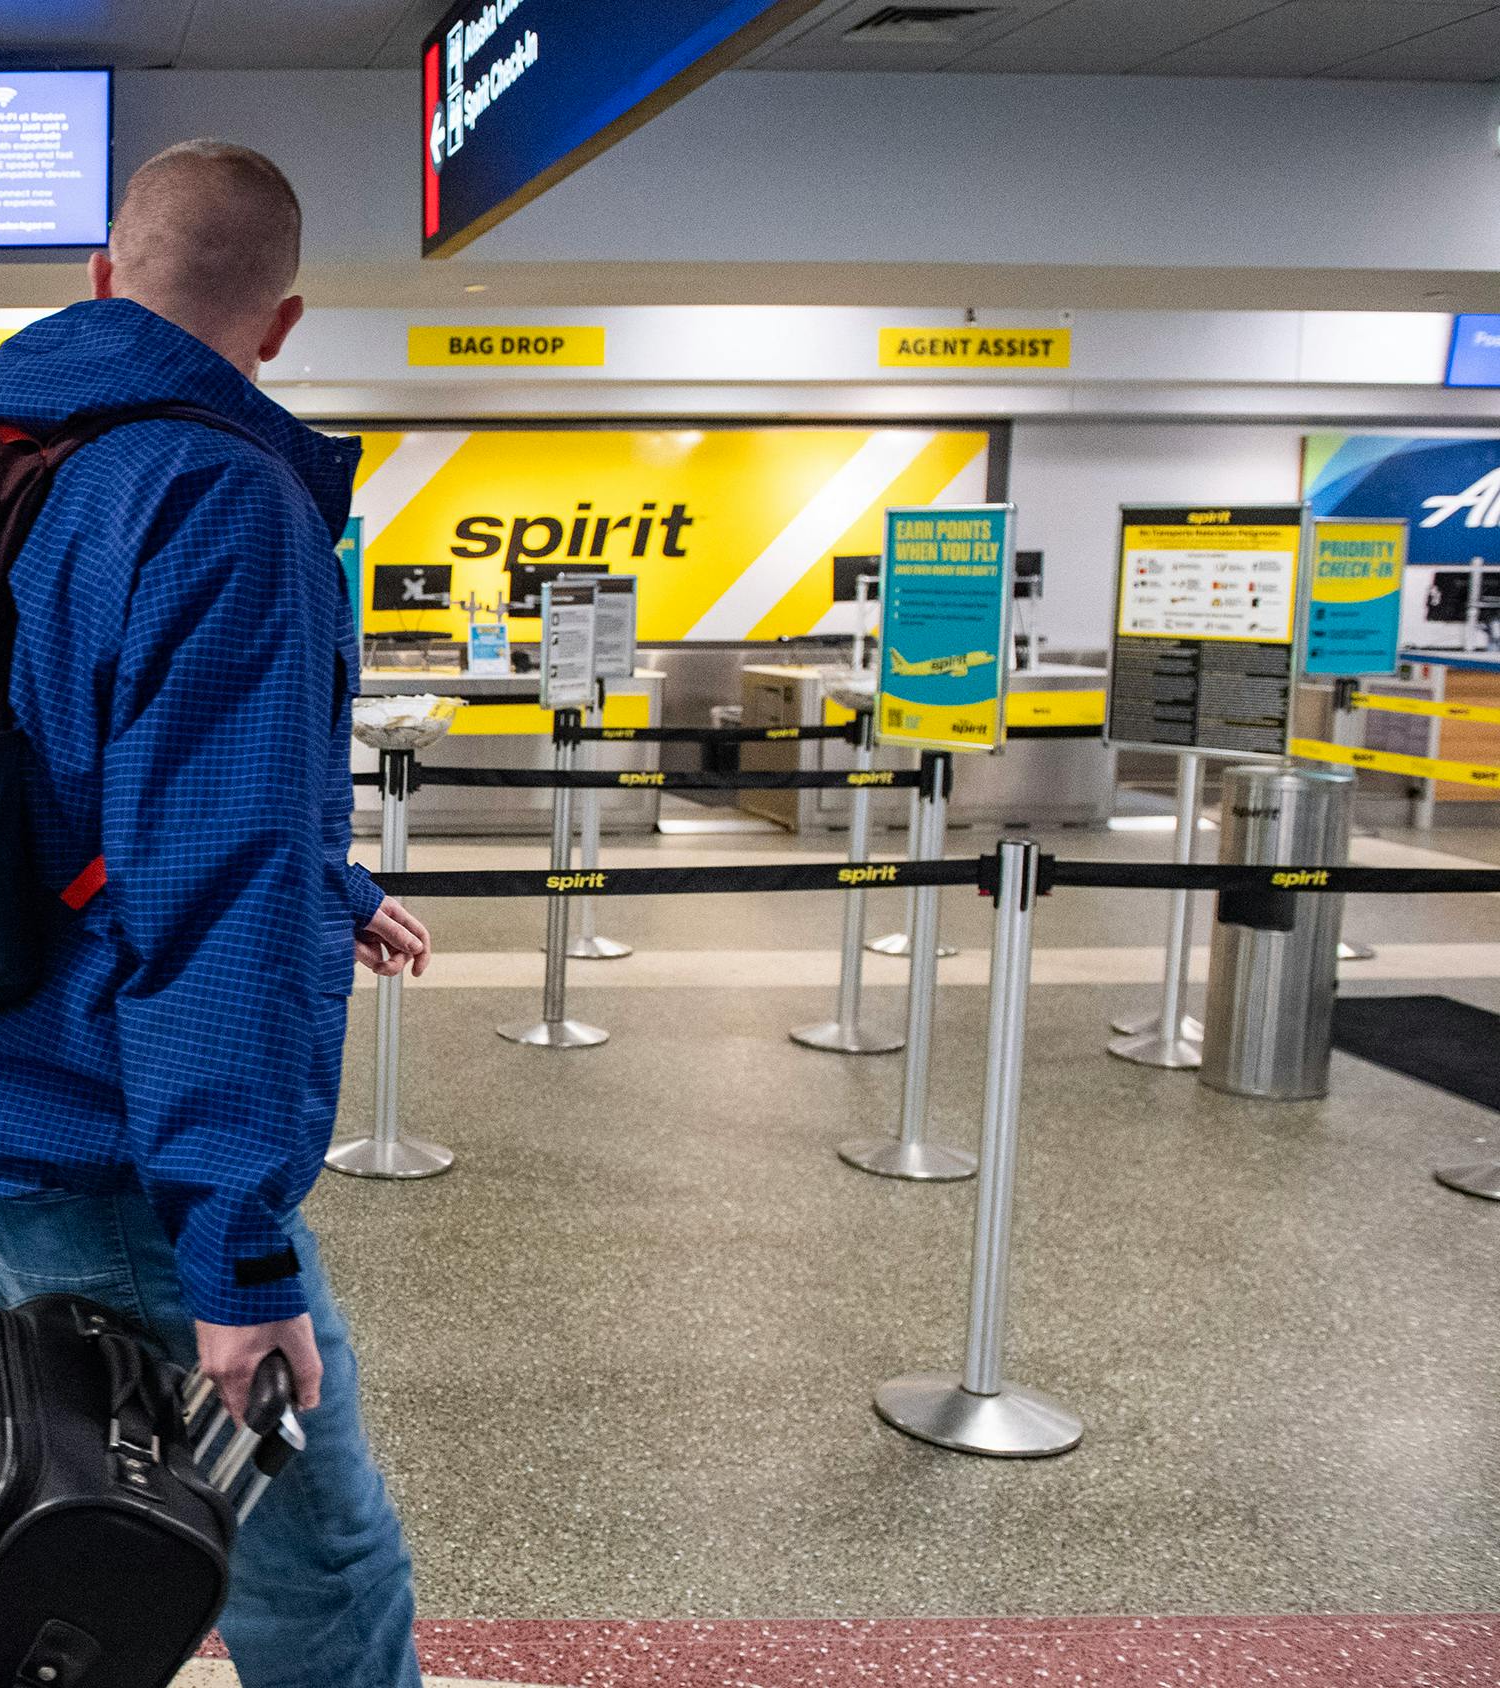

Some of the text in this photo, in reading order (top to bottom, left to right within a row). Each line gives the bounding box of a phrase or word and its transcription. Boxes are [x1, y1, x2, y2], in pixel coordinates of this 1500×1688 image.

[464, 30, 539, 131] Spirit Check-In
[31, 189, 53, 198] now
[449, 336, 565, 355] BAG DROP
[898, 338, 1054, 357] AGENT ASSIST
[1187, 511, 1232, 525] spirit
[450, 502, 694, 573] spirit
[895, 519, 992, 540] EARN POINTS
[895, 541, 1000, 562] WHEN YOU FLY
[1319, 541, 1396, 558] PRIORITY
[1318, 561, 1394, 578] CHECK-IN
[931, 655, 968, 670] spirit
[766, 728, 800, 740] spirit
[952, 722, 988, 736] spirit
[618, 772, 665, 786] spirit
[847, 772, 894, 786] spirit
[546, 873, 606, 891] spirit
[838, 865, 898, 883] spirit
[1271, 871, 1329, 888] spirit
